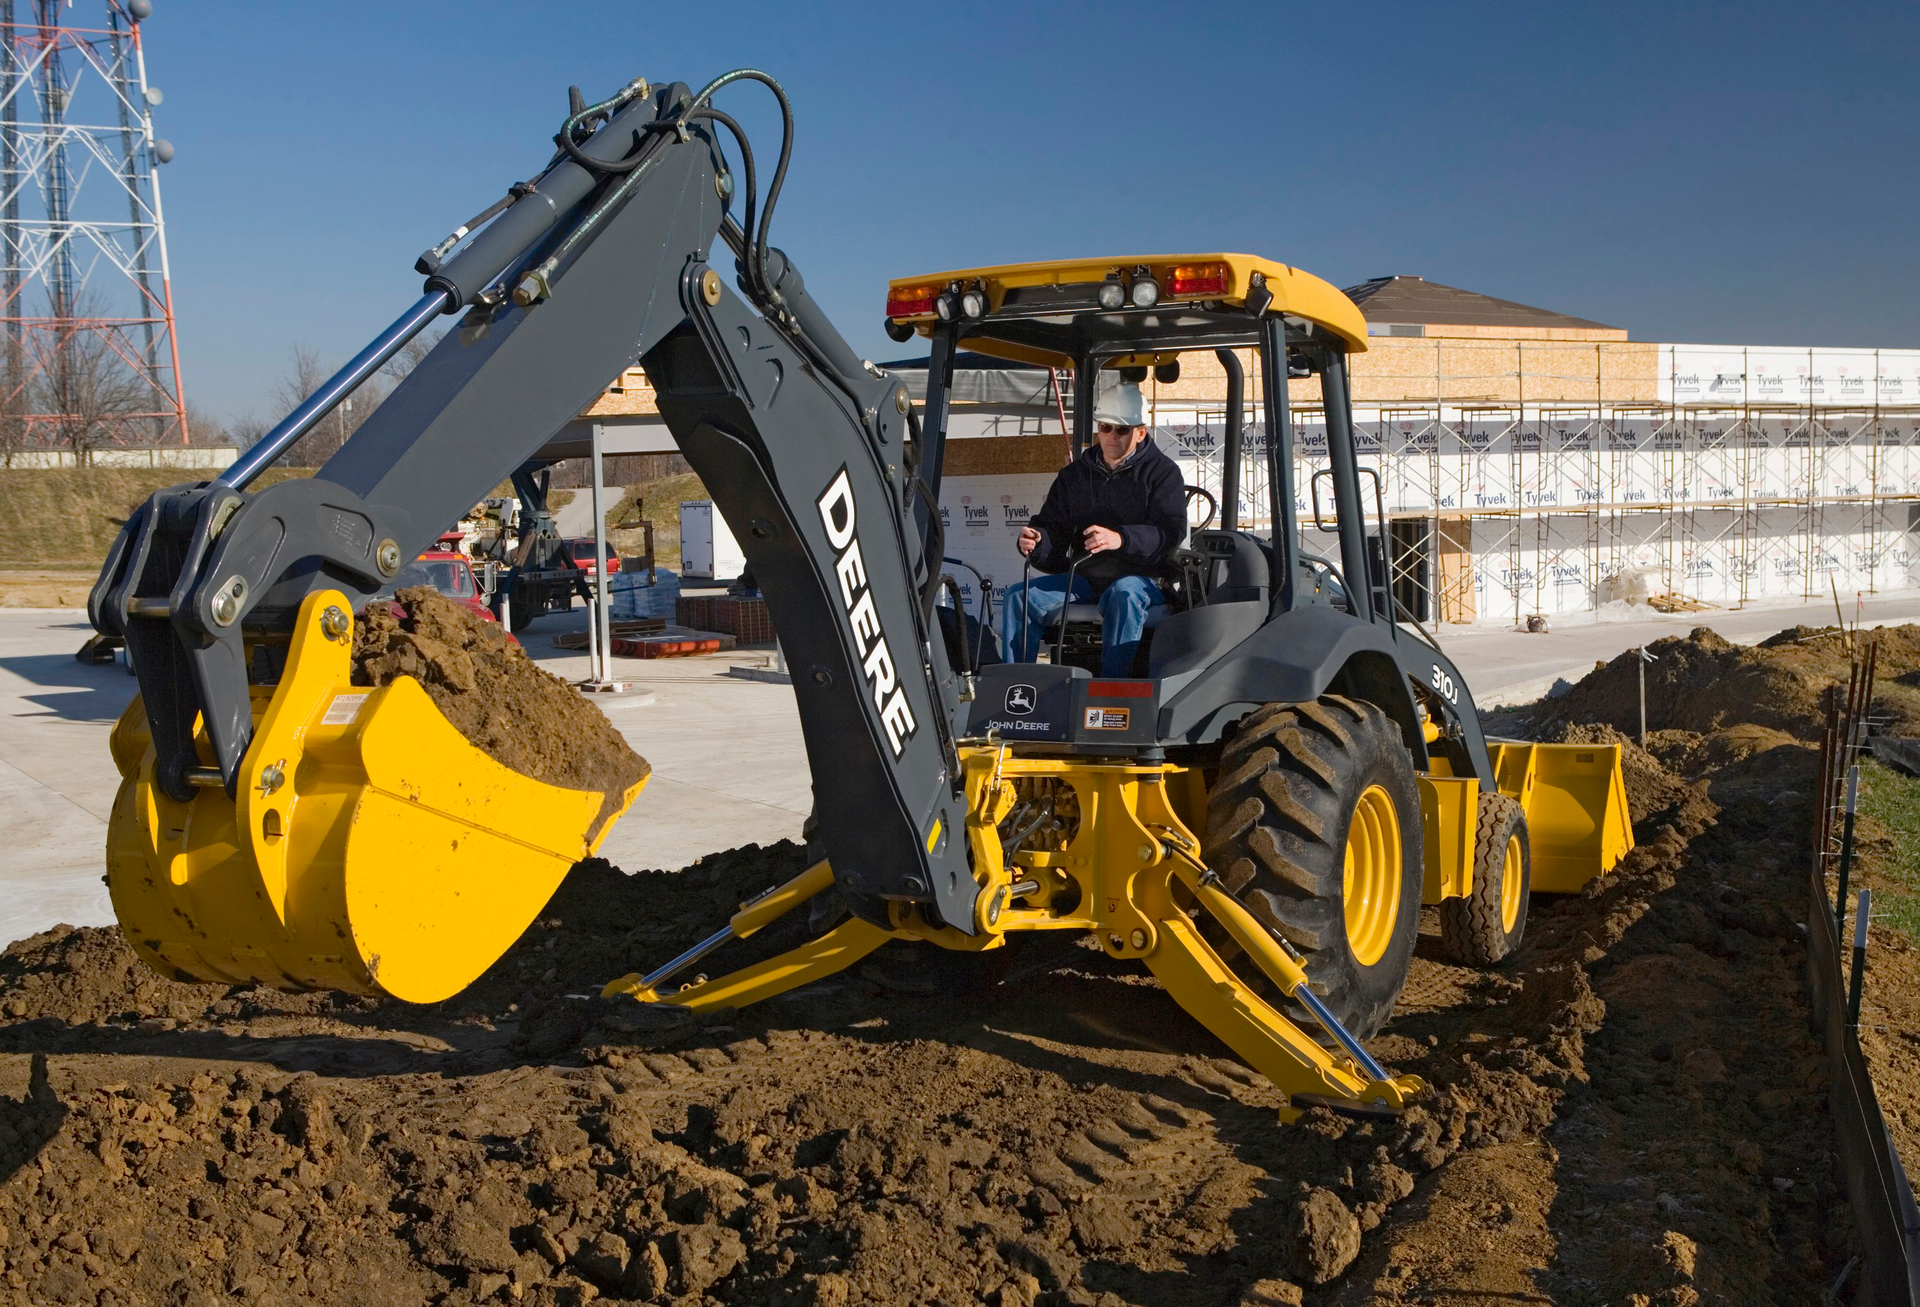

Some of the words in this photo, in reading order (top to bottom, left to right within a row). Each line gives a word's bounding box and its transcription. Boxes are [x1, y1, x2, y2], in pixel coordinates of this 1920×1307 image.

[1757, 374, 1783, 387] Tyvek
[1799, 375, 1824, 387] Tyvek
[1839, 375, 1864, 388] Tyvek
[1879, 375, 1902, 388] Tyvek
[1176, 433, 1215, 447] Tyvek
[1457, 430, 1489, 443] Tyvek
[1558, 430, 1589, 443] Tyvek
[1699, 429, 1725, 442] Tyvek
[1575, 489, 1604, 502] Tyvek
[1707, 486, 1734, 499] Tyvek
[1835, 485, 1860, 496] Tyvek
[1875, 483, 1898, 495] Tyvek
[1475, 493, 1506, 507] Tyvek
[1526, 491, 1556, 505] Tyvek
[964, 505, 988, 520] Tyvek
[1003, 505, 1029, 520] Tyvek
[1551, 564, 1581, 579] Tyvek
[818, 468, 917, 757] DEERE
[1431, 664, 1458, 705] 310J
[985, 719, 1014, 731] JOHN
[1015, 720, 1050, 731] DEERE
